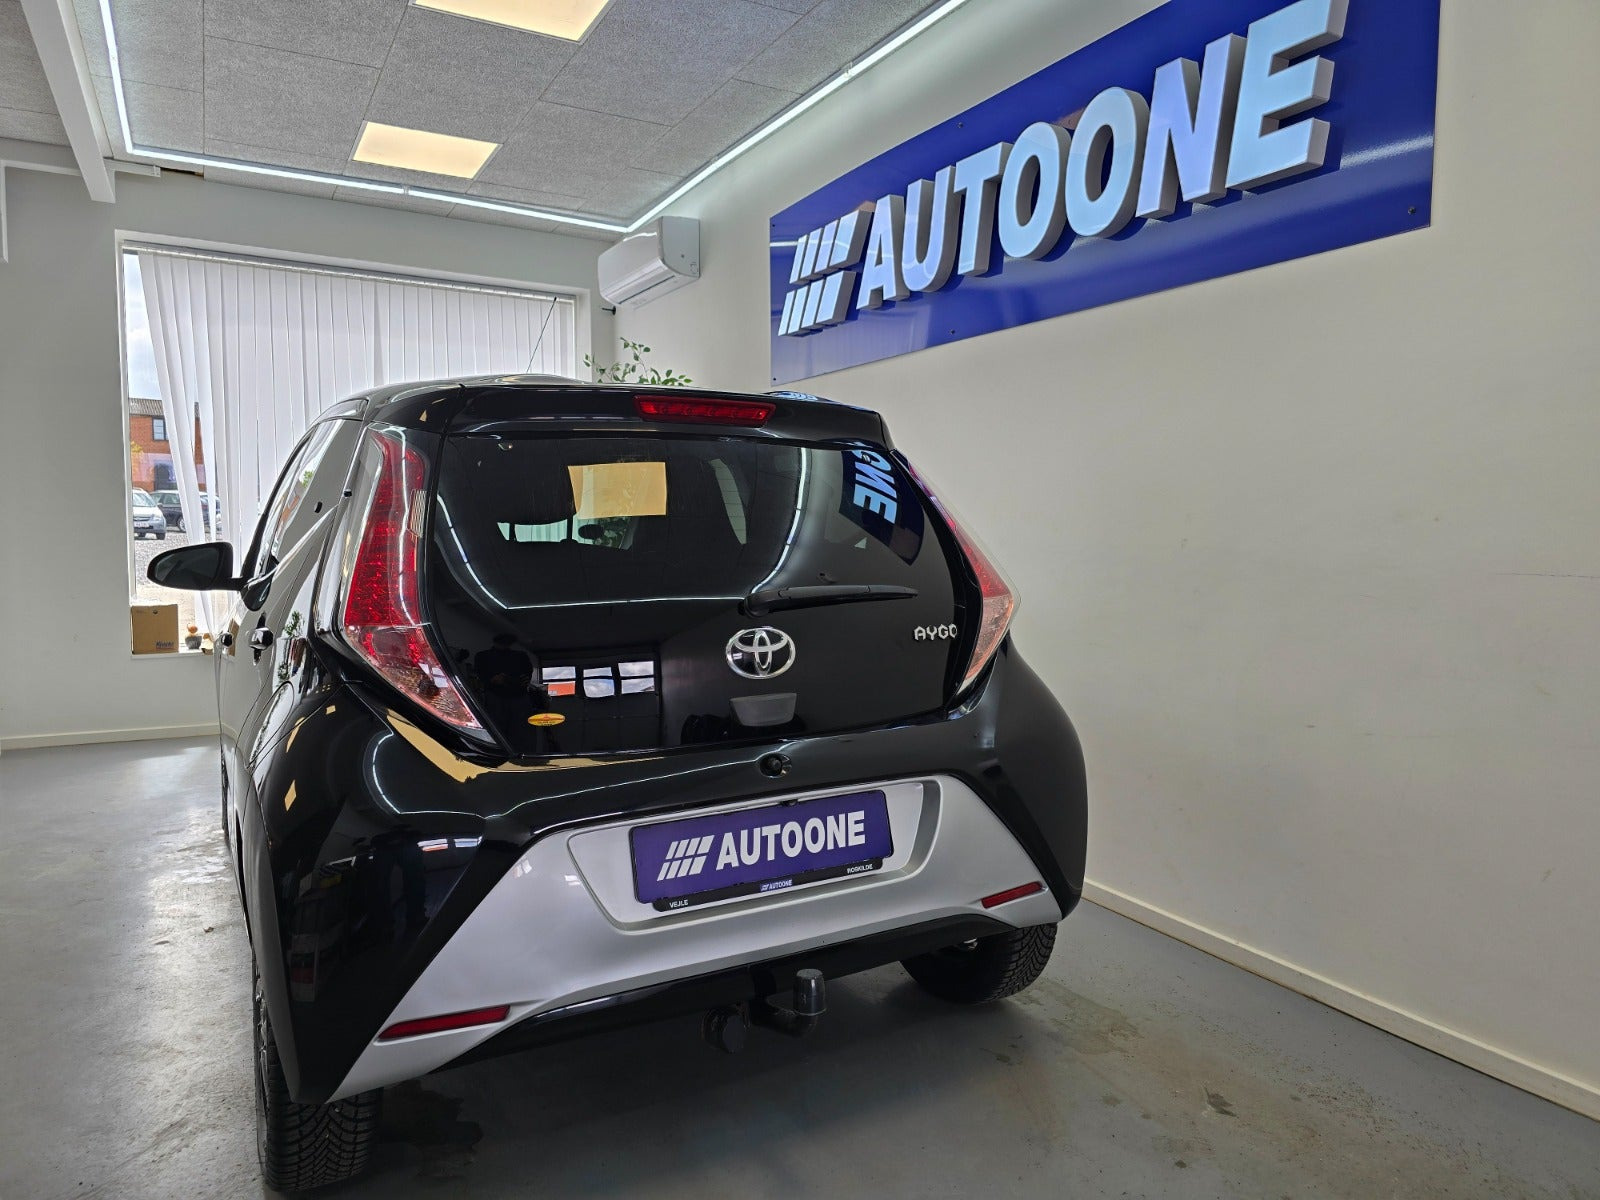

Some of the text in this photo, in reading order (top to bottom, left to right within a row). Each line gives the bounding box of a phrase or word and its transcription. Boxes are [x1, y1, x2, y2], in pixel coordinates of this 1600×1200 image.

[856, 0, 1349, 310] AUTOONE
[913, 623, 958, 641] AYGO
[716, 810, 866, 871] AUTOONE
[769, 878, 793, 890] AUTOONE
[669, 899, 689, 909] VEJLE
